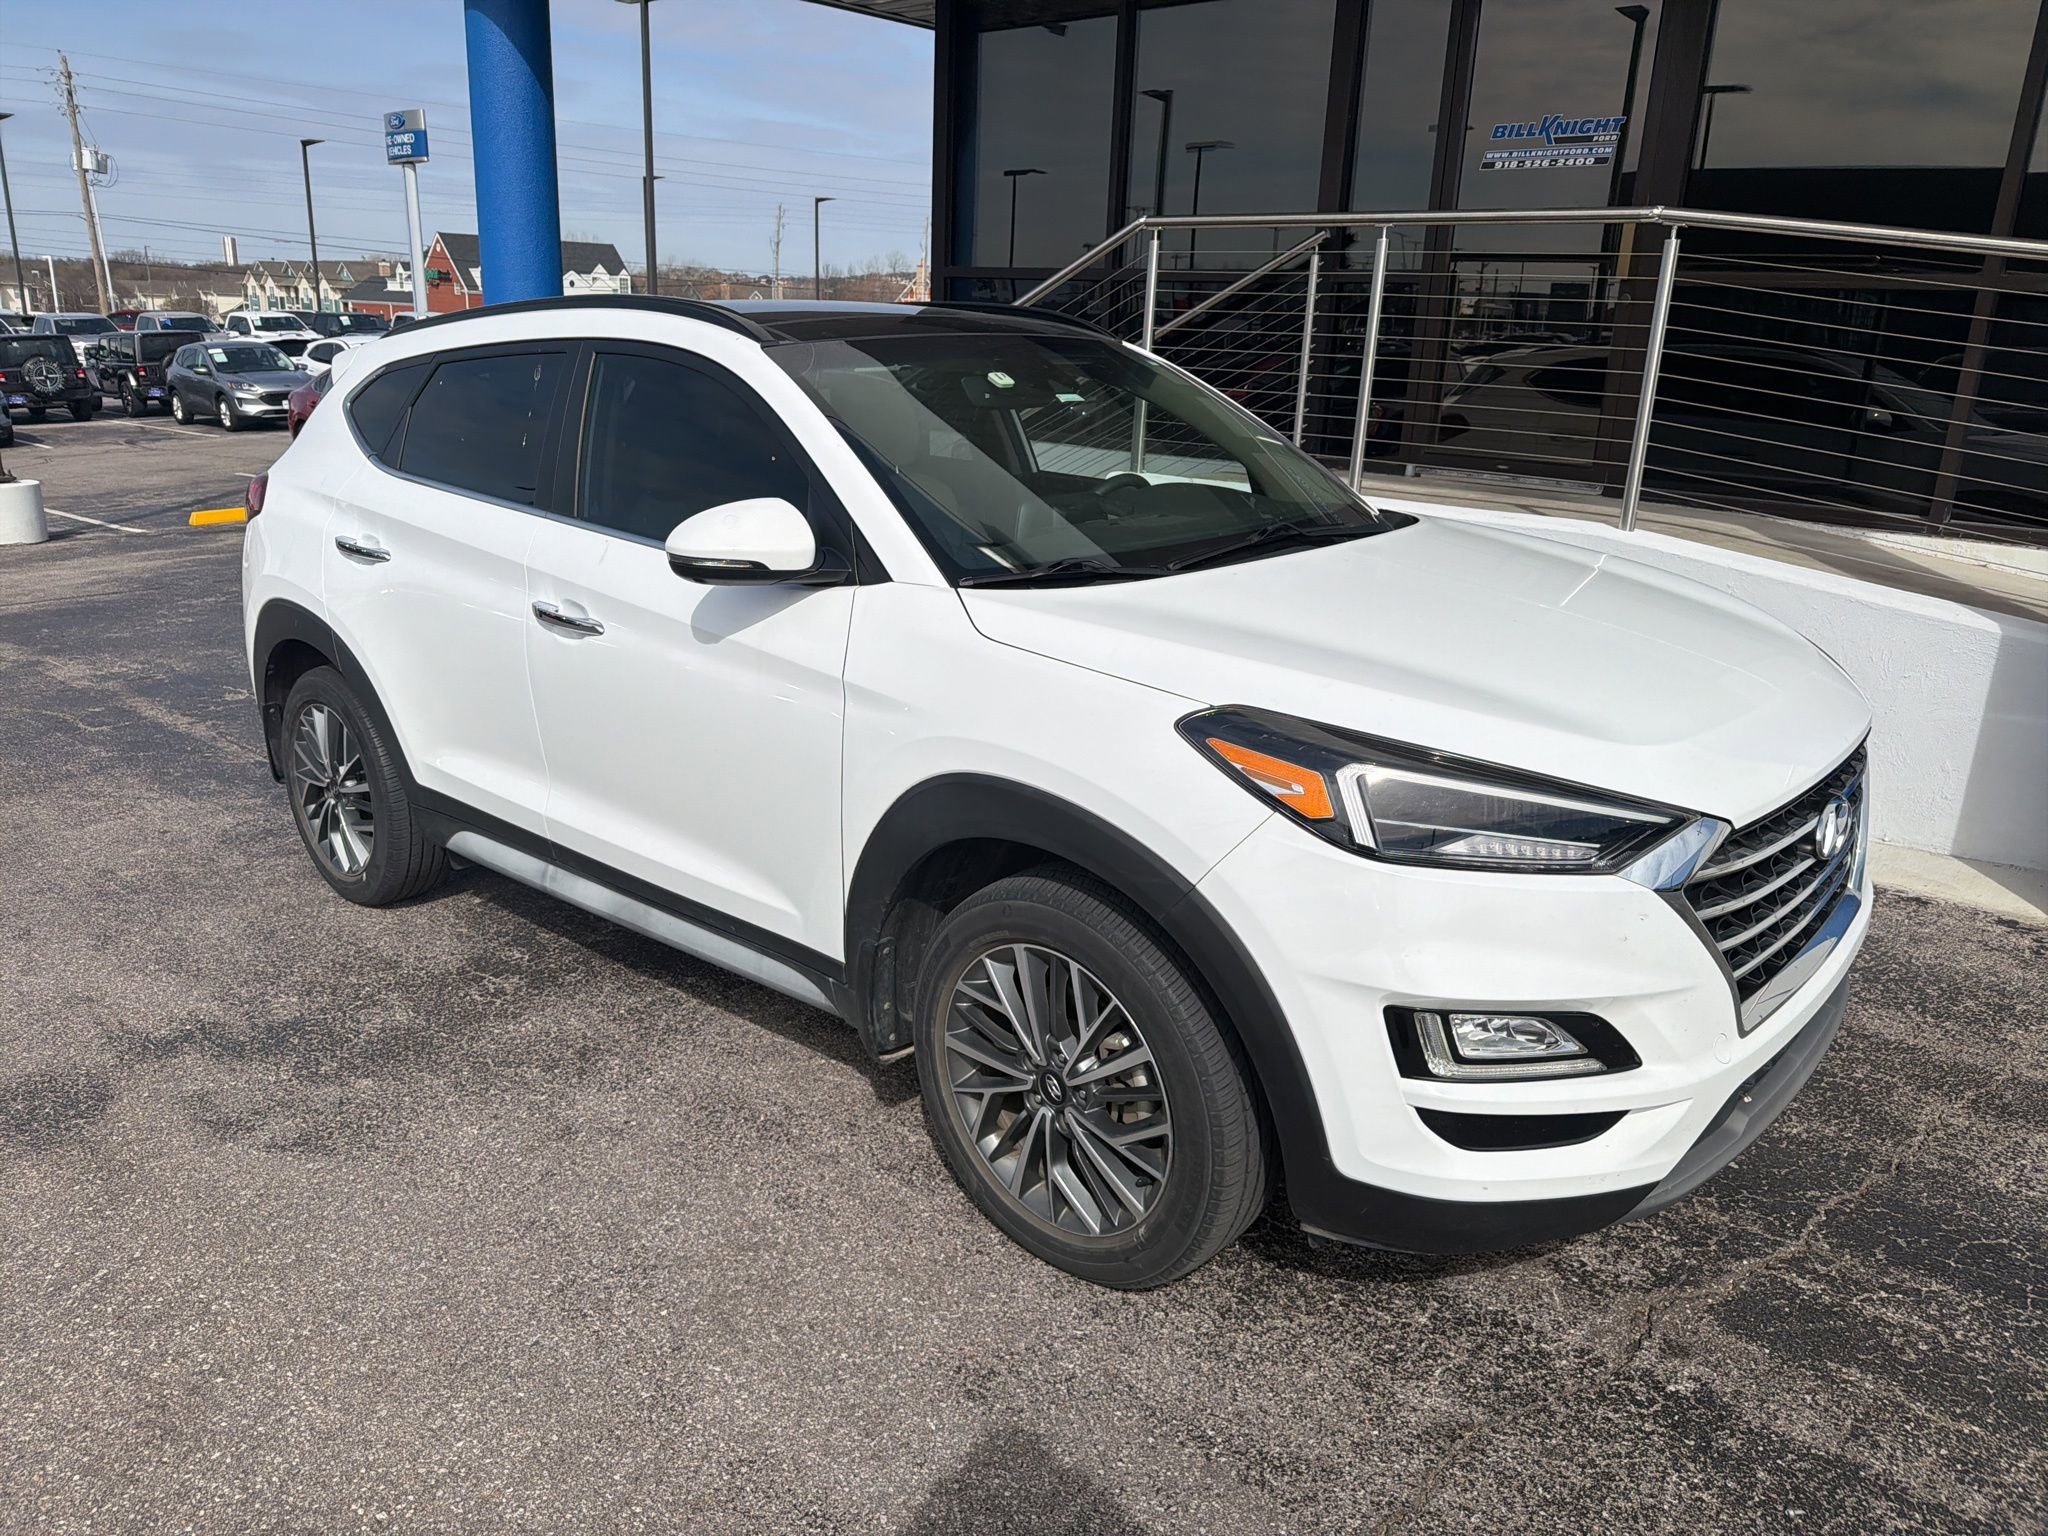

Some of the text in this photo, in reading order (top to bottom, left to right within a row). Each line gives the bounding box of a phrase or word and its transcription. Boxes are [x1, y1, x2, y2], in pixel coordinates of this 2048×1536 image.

[1592, 134, 1617, 142] FORD
[1486, 146, 1613, 159] WWW.BILLKNIGHTFORD.COM
[1494, 157, 1596, 169] 918-526-2400
